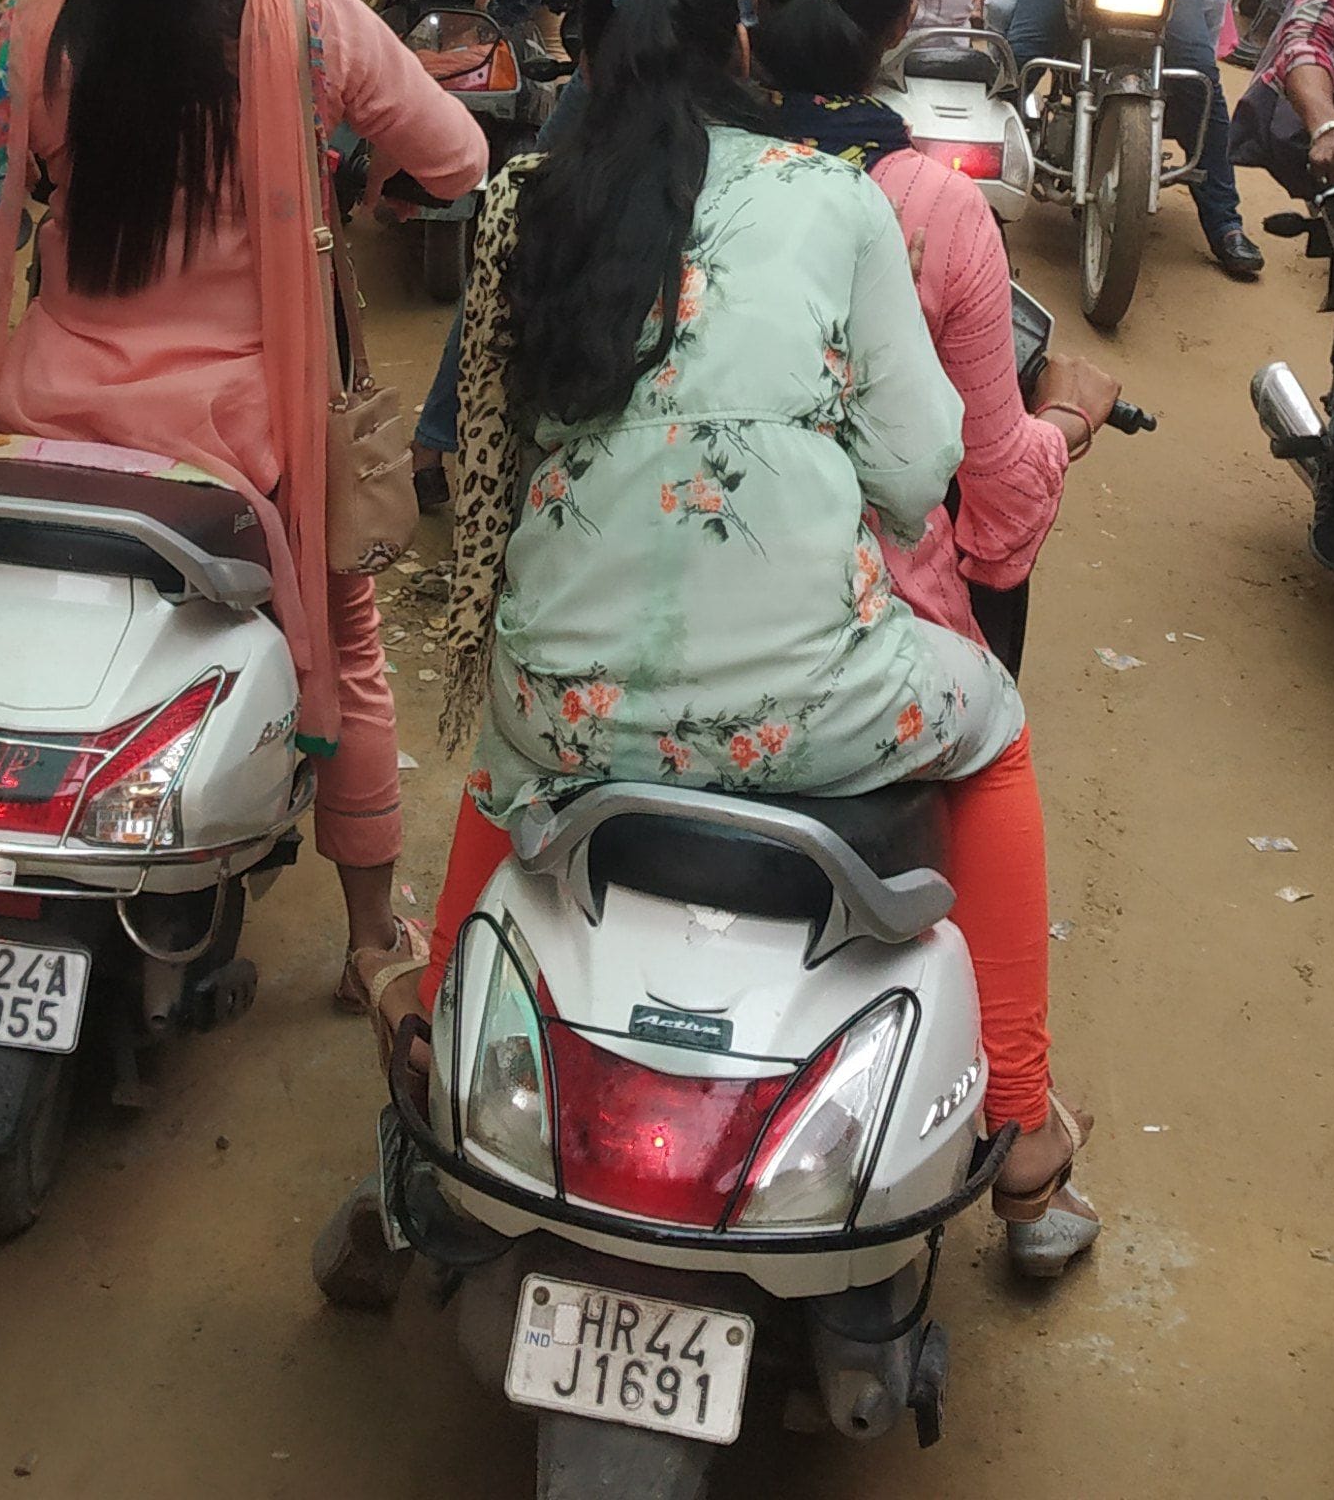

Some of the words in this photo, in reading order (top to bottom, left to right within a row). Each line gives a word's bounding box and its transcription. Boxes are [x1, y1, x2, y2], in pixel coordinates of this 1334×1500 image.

[634, 1015, 722, 1036] Activa
[524, 1330, 551, 1348] IND
[578, 1296, 708, 1367] HR44
[554, 1347, 711, 1424] J1691
